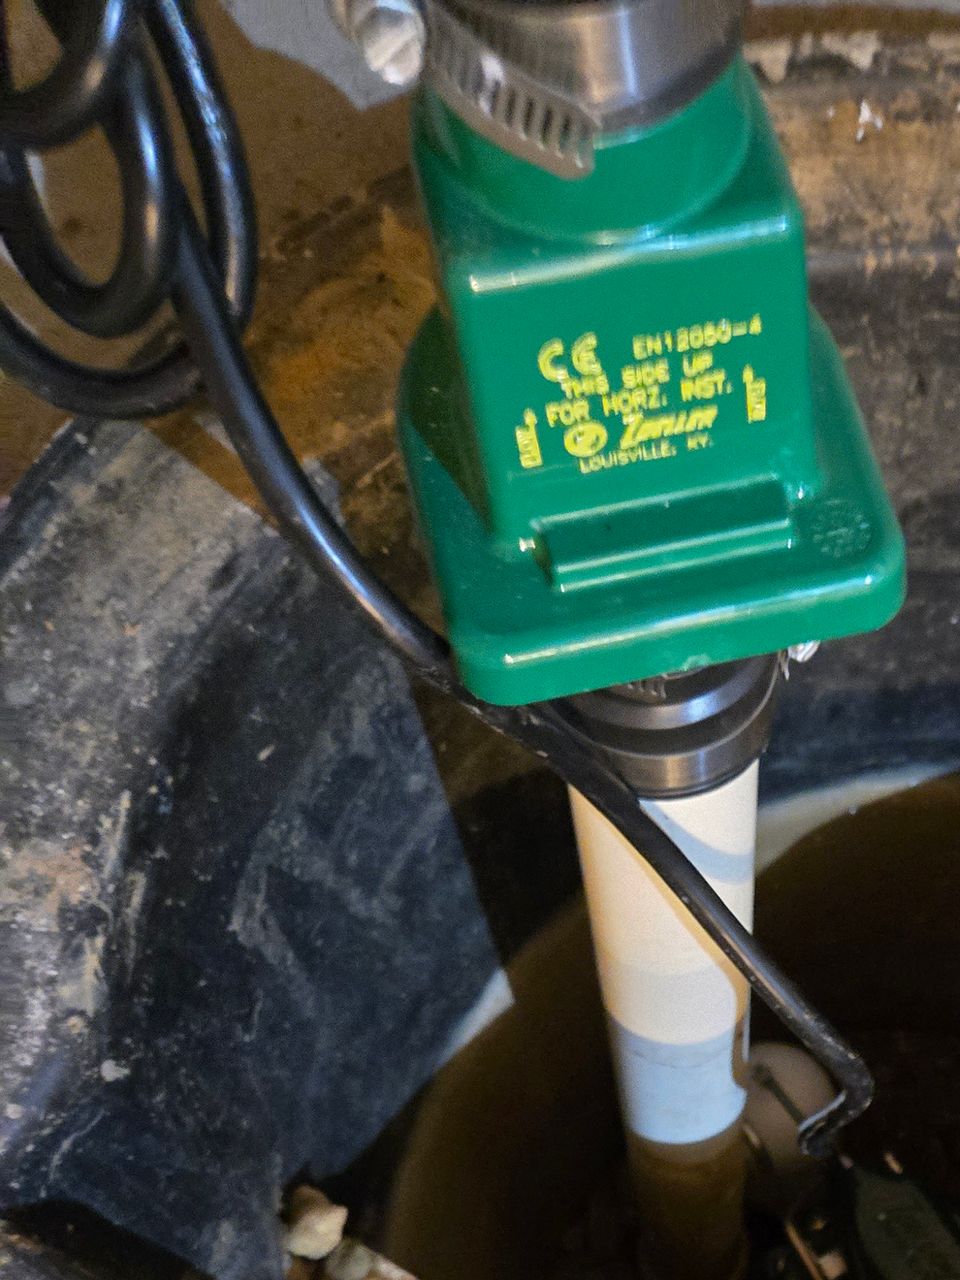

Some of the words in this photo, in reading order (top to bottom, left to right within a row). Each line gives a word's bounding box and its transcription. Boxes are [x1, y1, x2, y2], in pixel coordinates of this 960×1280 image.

[622, 359, 669, 388] SIDE
[683, 351, 713, 376] UP
[546, 399, 588, 426] FOR
